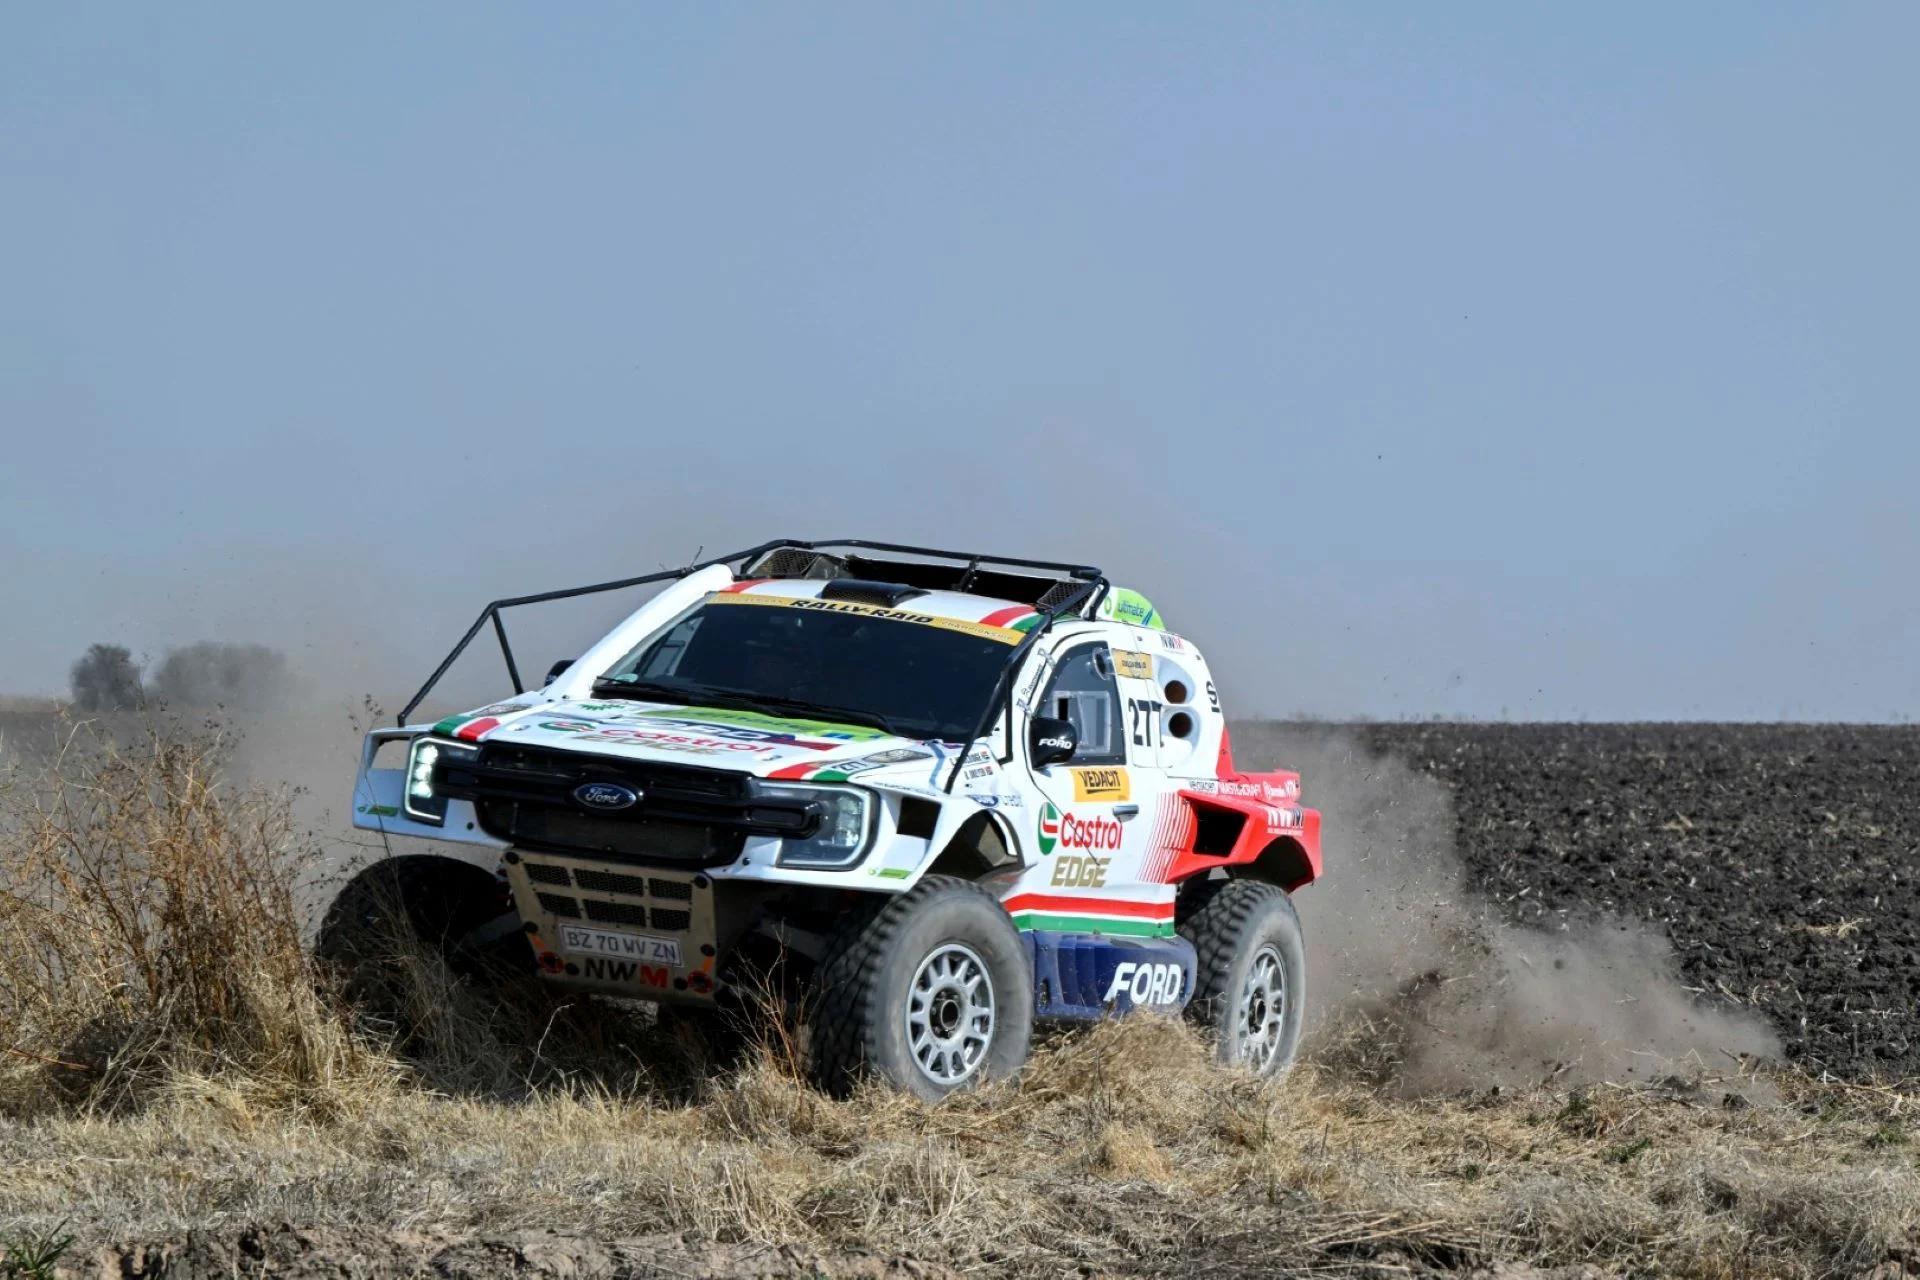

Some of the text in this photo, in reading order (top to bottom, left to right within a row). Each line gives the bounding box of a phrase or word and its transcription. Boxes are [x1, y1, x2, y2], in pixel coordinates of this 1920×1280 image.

[1117, 600, 1144, 618] ultimate
[1038, 738, 1072, 750] FORD
[1079, 770, 1121, 787] VEDACIT
[585, 787, 621, 803] Ford
[1061, 812, 1123, 850] Castrol
[1050, 855, 1112, 888] EDGE
[567, 932, 592, 949] BZ
[622, 938, 646, 955] WV
[651, 942, 676, 961] ZN
[585, 958, 668, 989] NWM
[1103, 962, 1182, 1005] FORD
